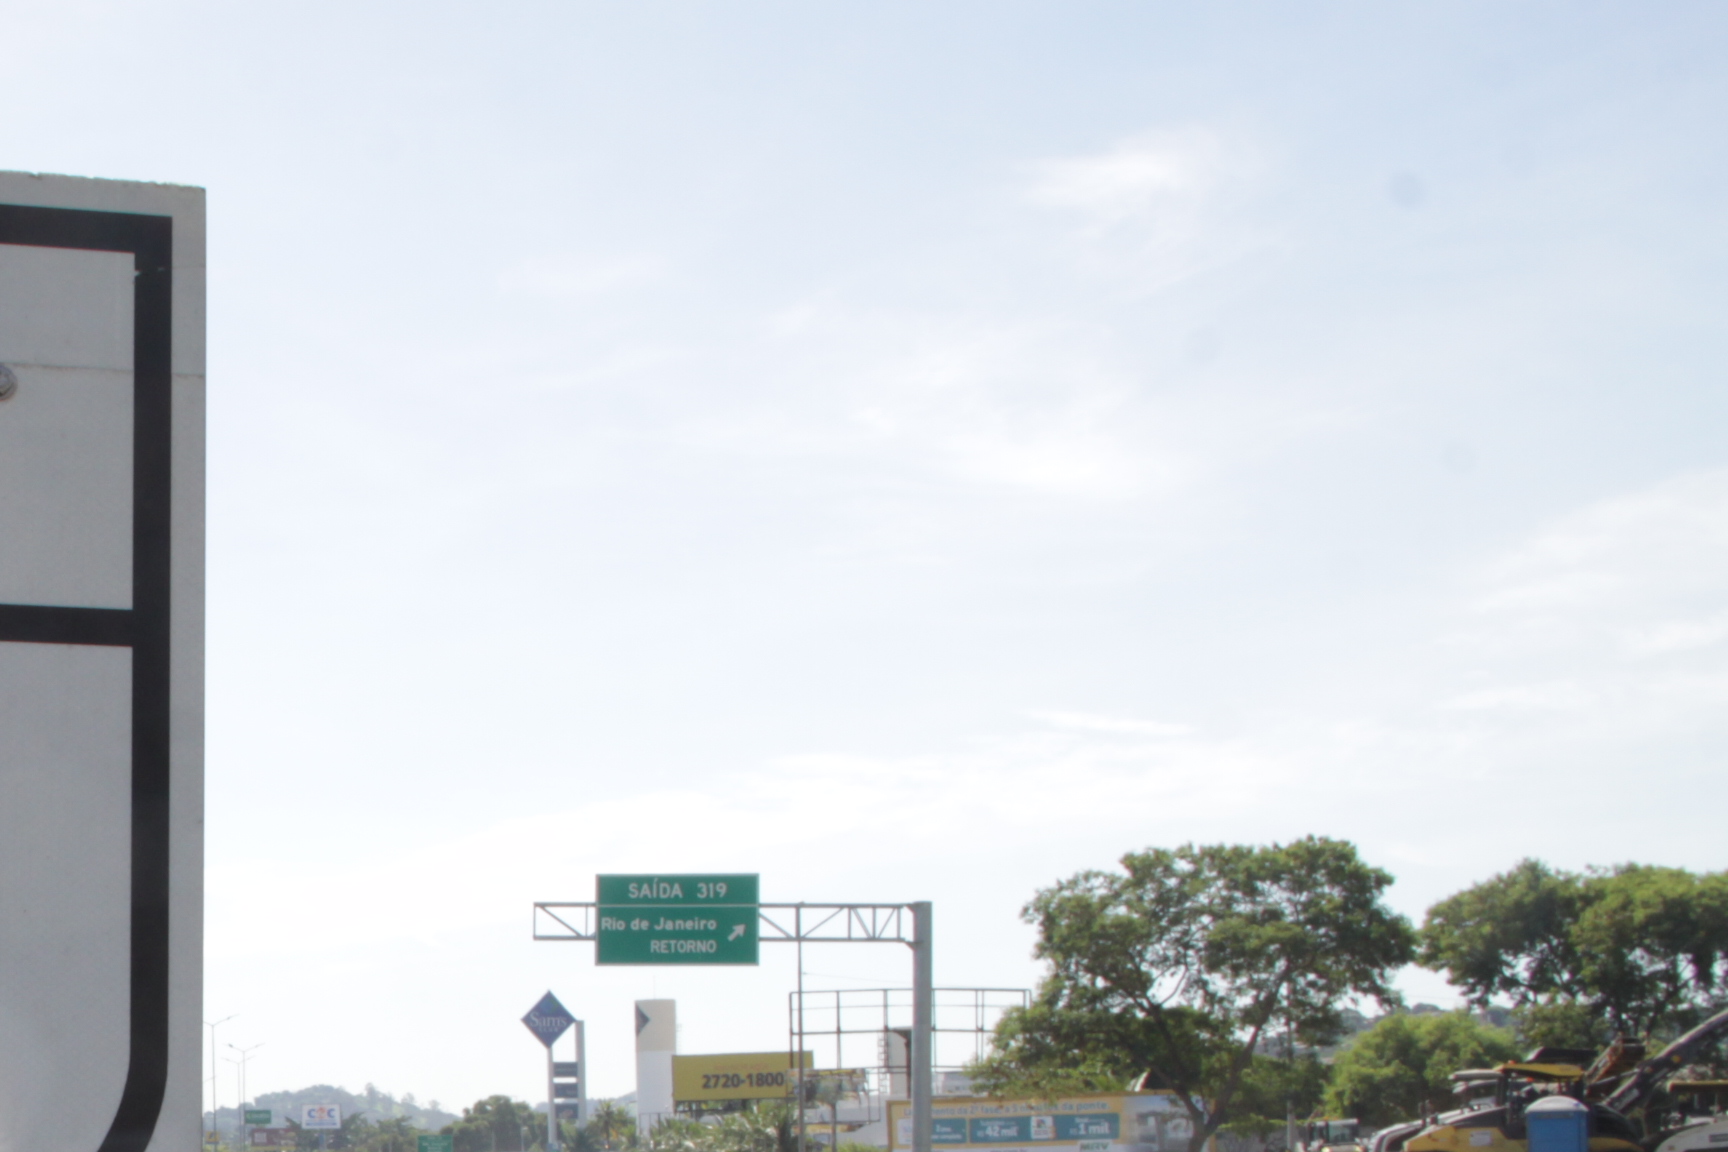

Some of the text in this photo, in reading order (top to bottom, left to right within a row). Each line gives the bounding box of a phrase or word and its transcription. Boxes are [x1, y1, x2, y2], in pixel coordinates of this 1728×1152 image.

[628, 878, 727, 898] SAÍDA 319
[601, 917, 717, 930] Rio de Janeiro
[650, 940, 717, 953] RETORNO
[702, 1072, 785, 1089] 2720-1800
